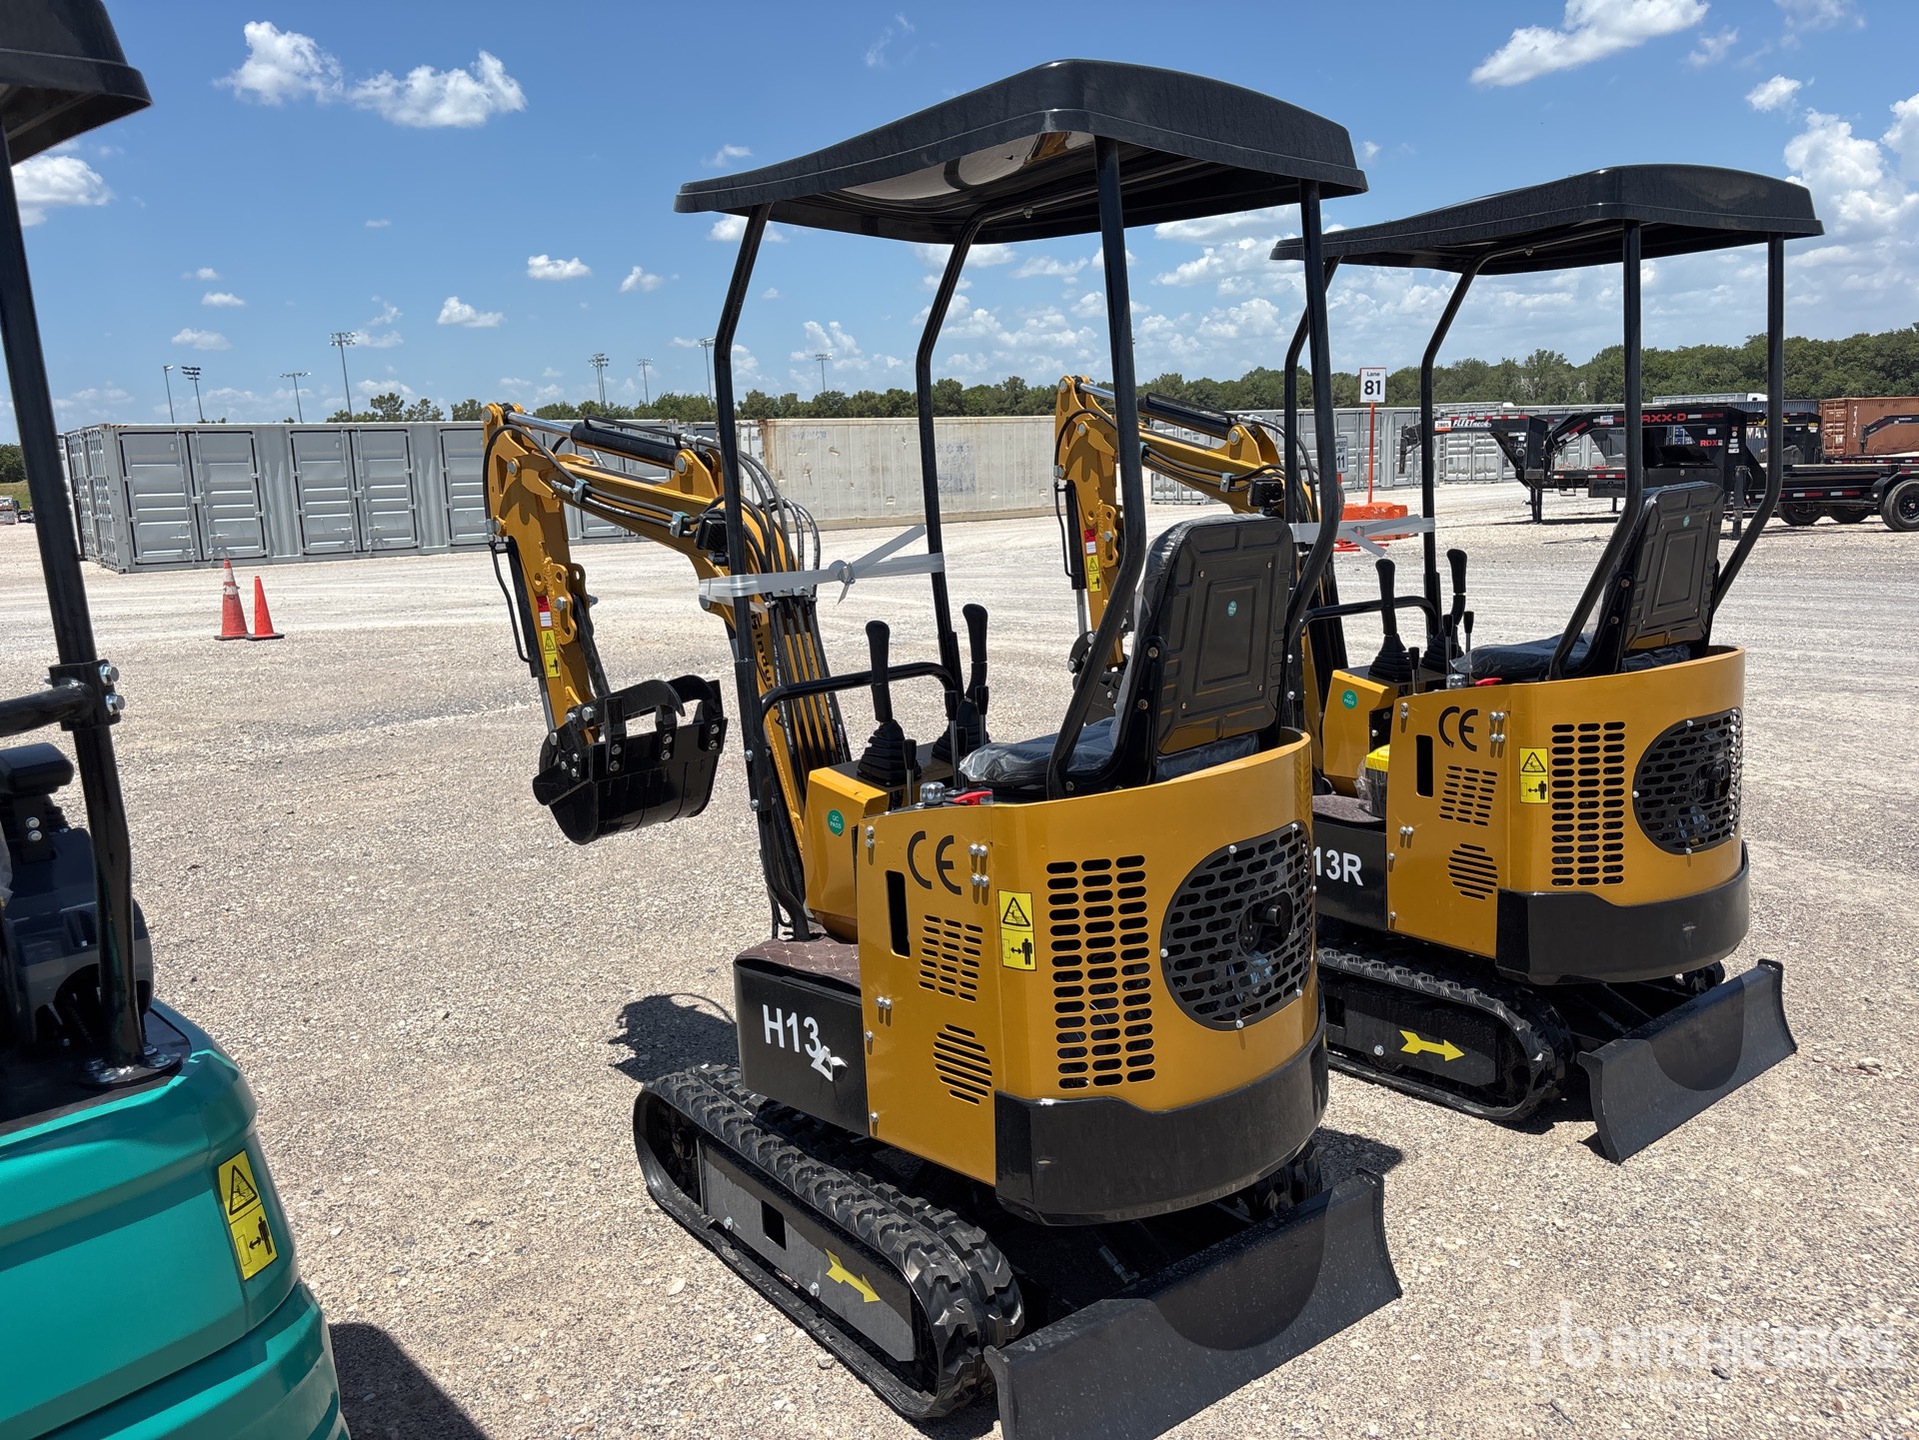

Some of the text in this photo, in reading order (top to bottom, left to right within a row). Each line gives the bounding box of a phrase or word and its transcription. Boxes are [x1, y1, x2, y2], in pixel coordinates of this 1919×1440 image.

[1364, 380, 1381, 395] 81
[1640, 413, 1687, 423] AXX-D
[1700, 439, 1718, 447] RDX
[1438, 705, 1479, 752] CE
[907, 830, 962, 896] CE
[1313, 846, 1364, 886] 13R
